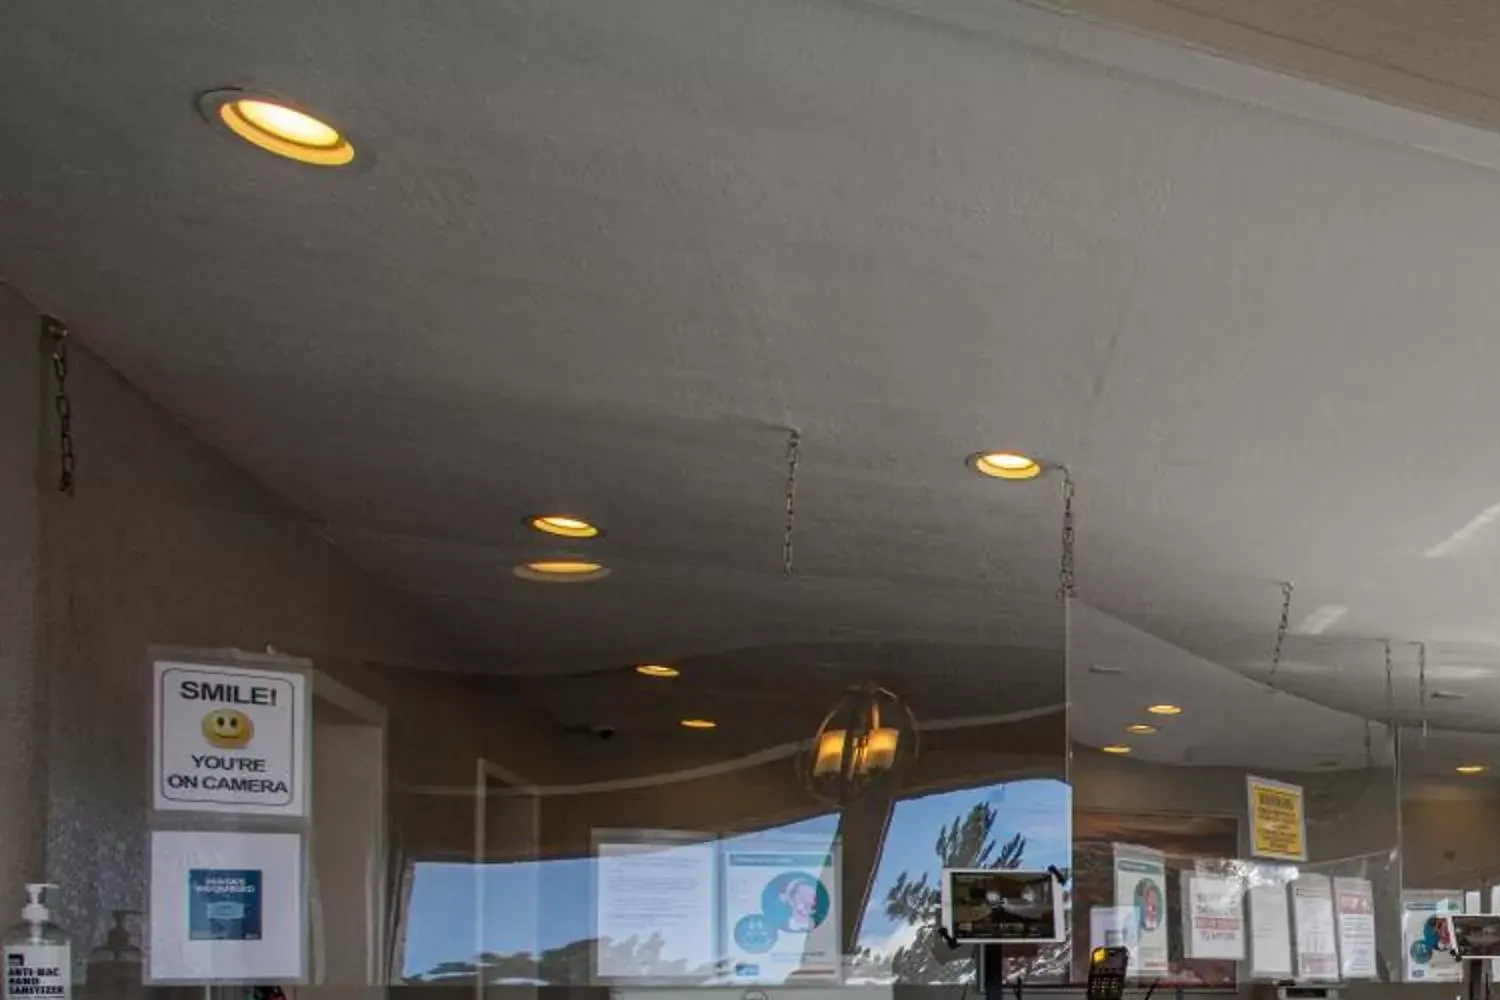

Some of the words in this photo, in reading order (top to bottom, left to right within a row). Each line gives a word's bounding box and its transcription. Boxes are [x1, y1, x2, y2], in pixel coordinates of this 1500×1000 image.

[180, 681, 278, 706] SMILE!
[191, 754, 267, 772] YOU'RE
[167, 774, 198, 789] ON
[201, 776, 288, 793] CAMERA
